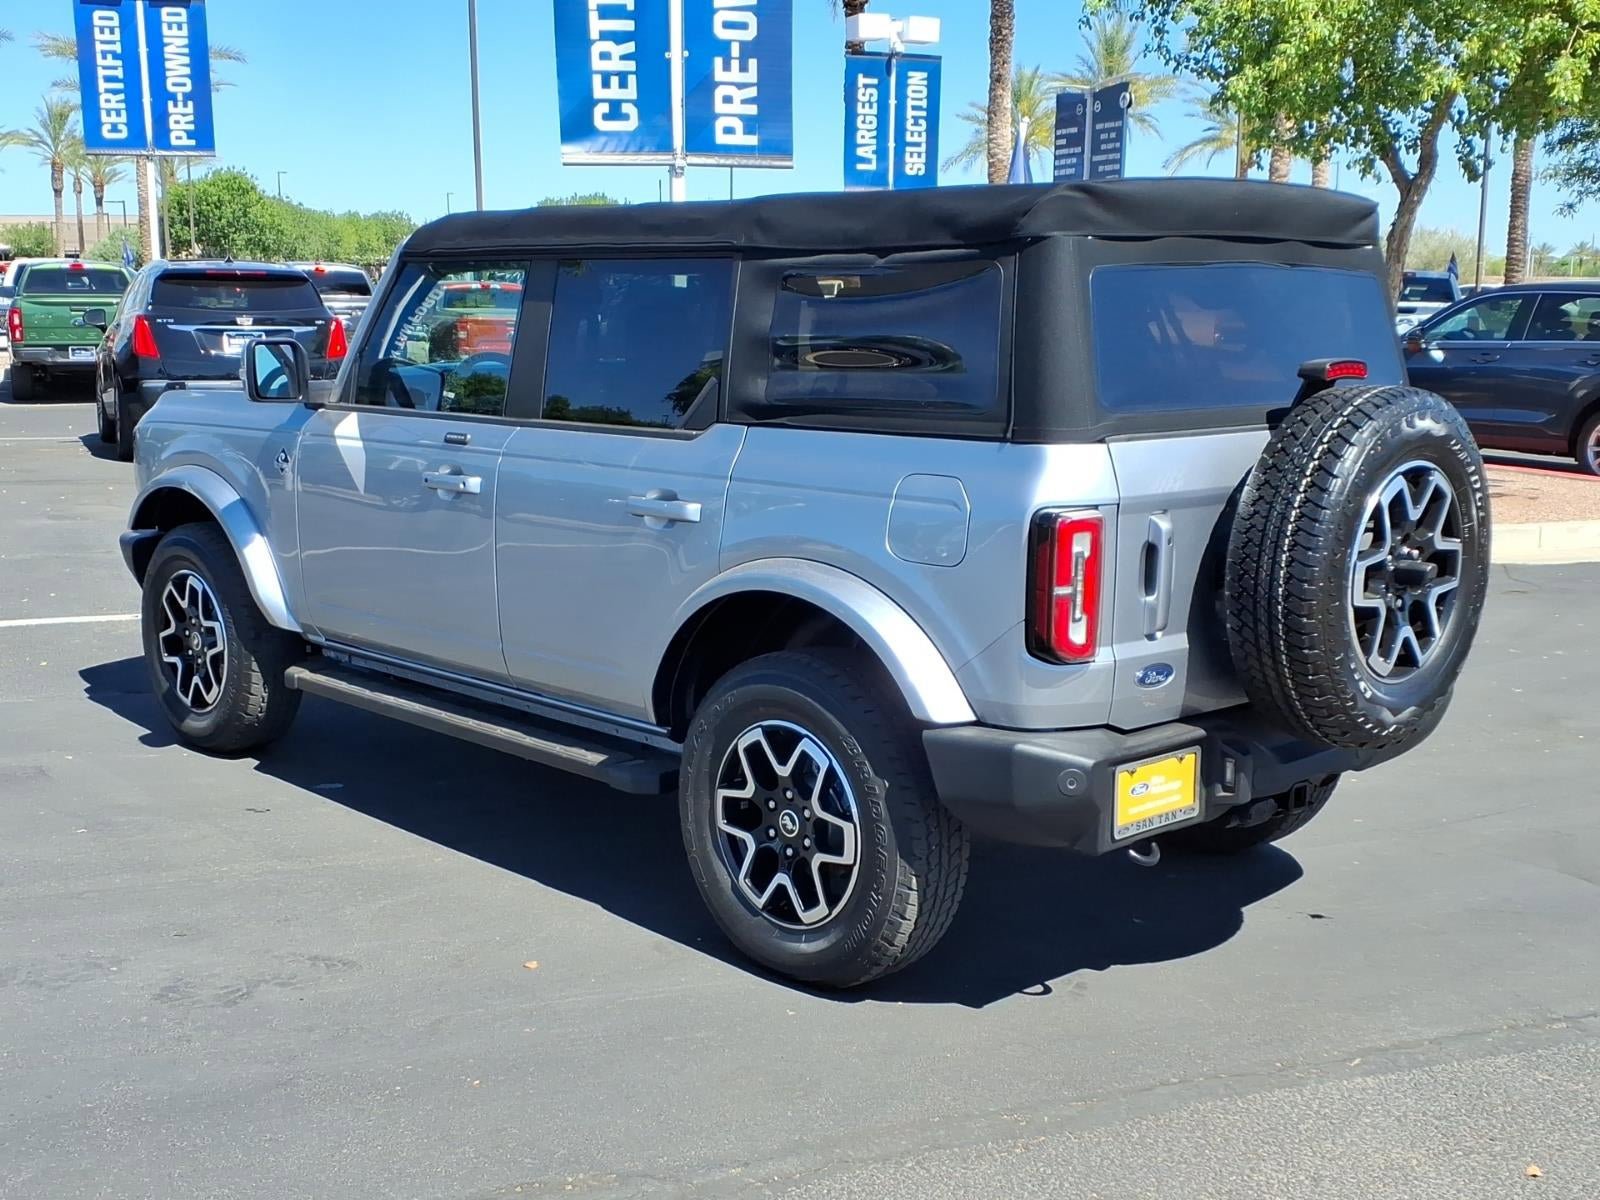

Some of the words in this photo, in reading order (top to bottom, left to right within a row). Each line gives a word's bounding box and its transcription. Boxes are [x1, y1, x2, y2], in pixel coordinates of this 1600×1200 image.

[92, 9, 128, 140] CERTIFIED
[160, 6, 197, 146] PRE-OWNED
[713, 0, 759, 146] PRE-O
[856, 73, 879, 171] LARGEST
[905, 71, 928, 176] SELECTION
[1135, 816, 1154, 831] SAN
[1158, 812, 1177, 823] TAN
